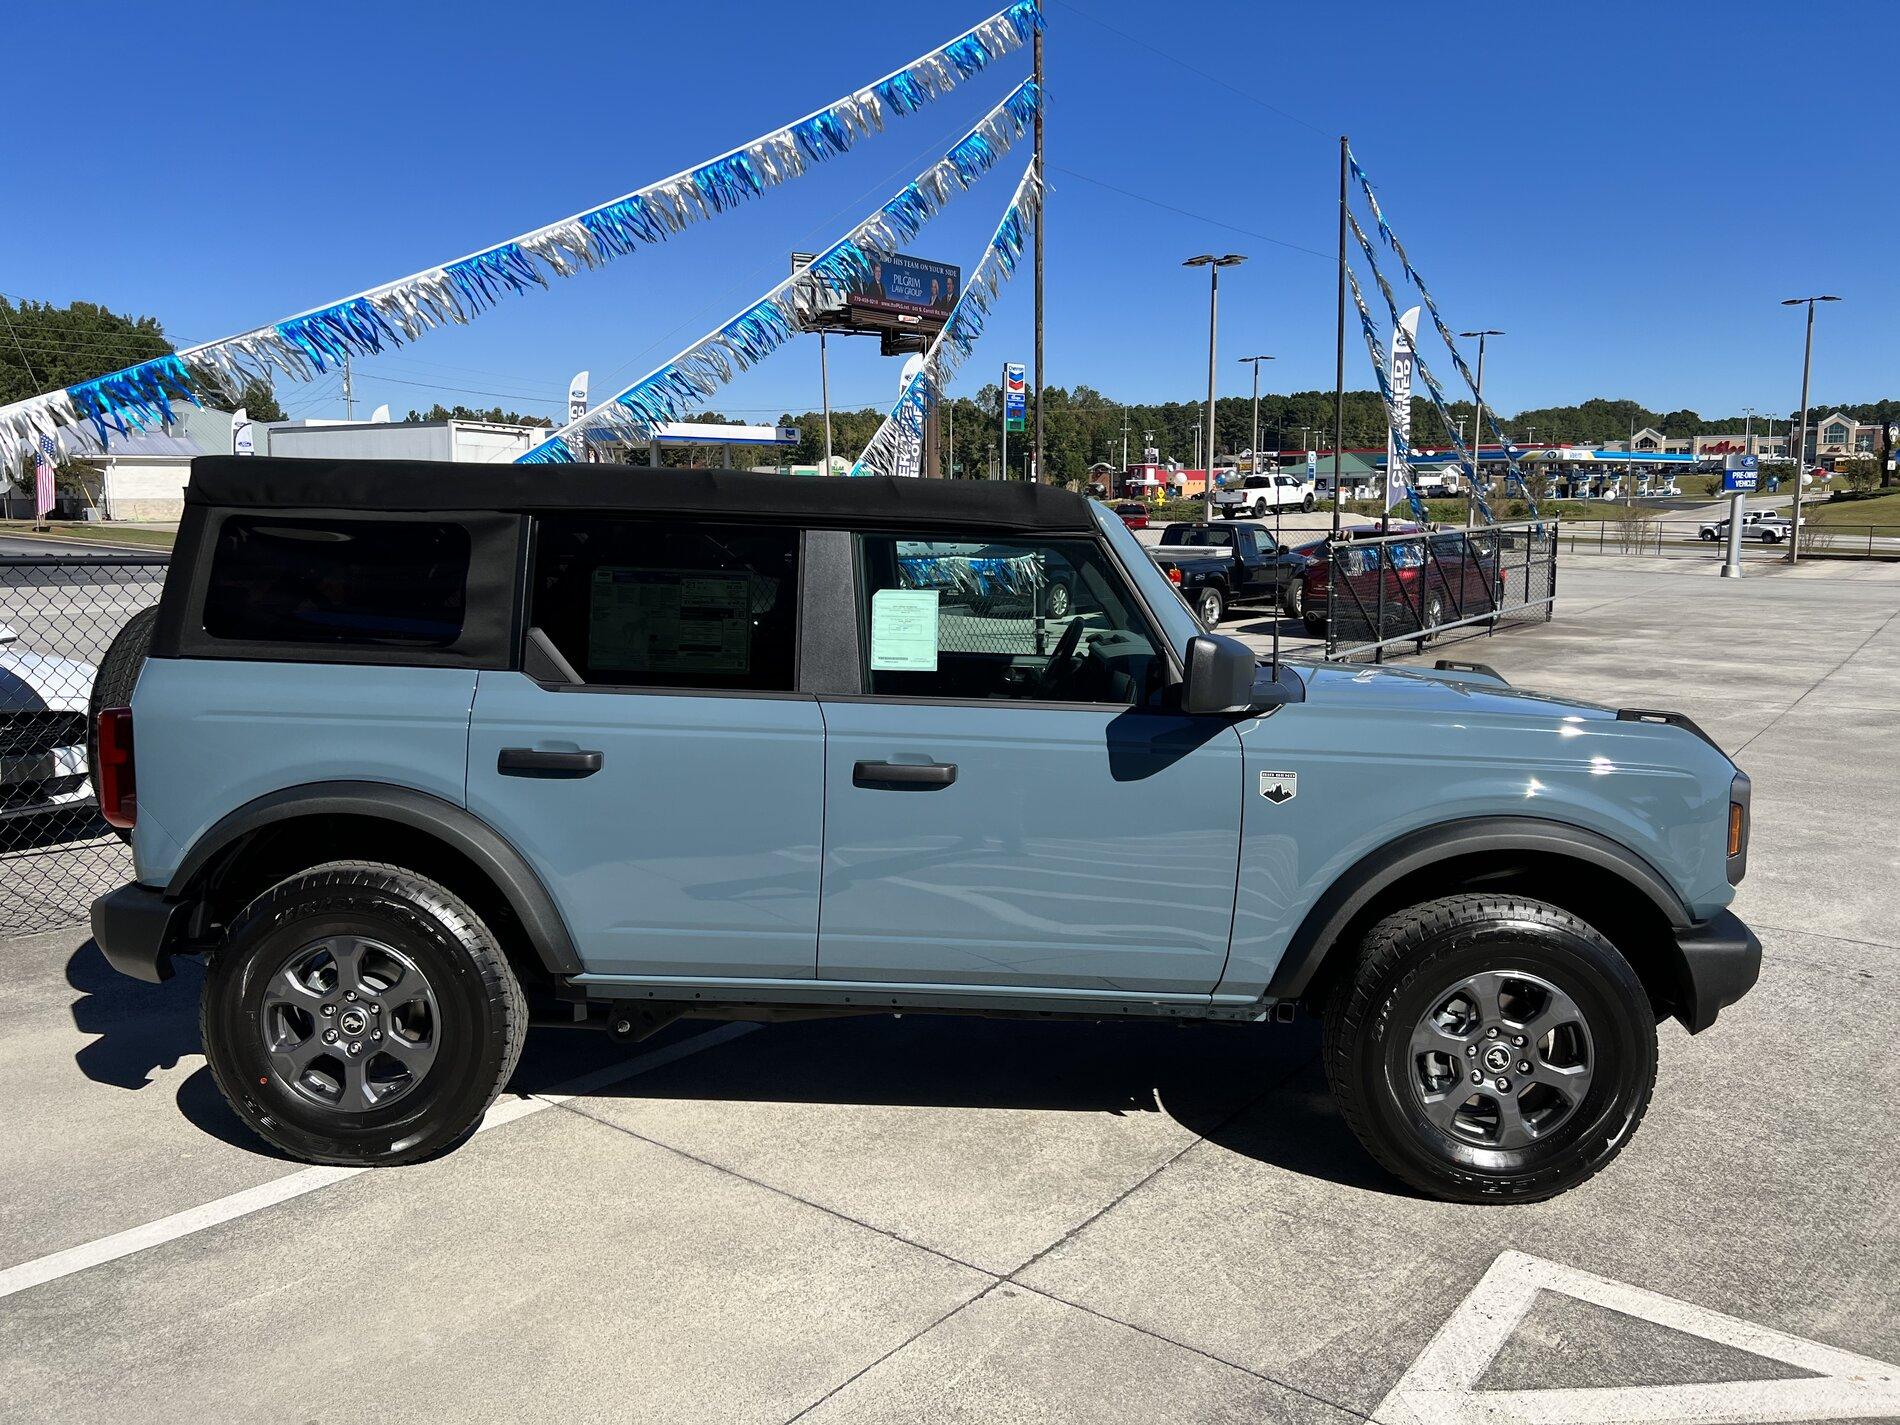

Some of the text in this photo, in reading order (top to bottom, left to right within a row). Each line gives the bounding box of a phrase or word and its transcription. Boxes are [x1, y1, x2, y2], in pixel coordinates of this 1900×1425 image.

[904, 260, 919, 270] TEAM
[928, 265, 945, 275] YOUR
[945, 269, 957, 277] SIDE
[893, 274, 921, 288] PILGRIM
[891, 284, 923, 296] LAW GROUP
